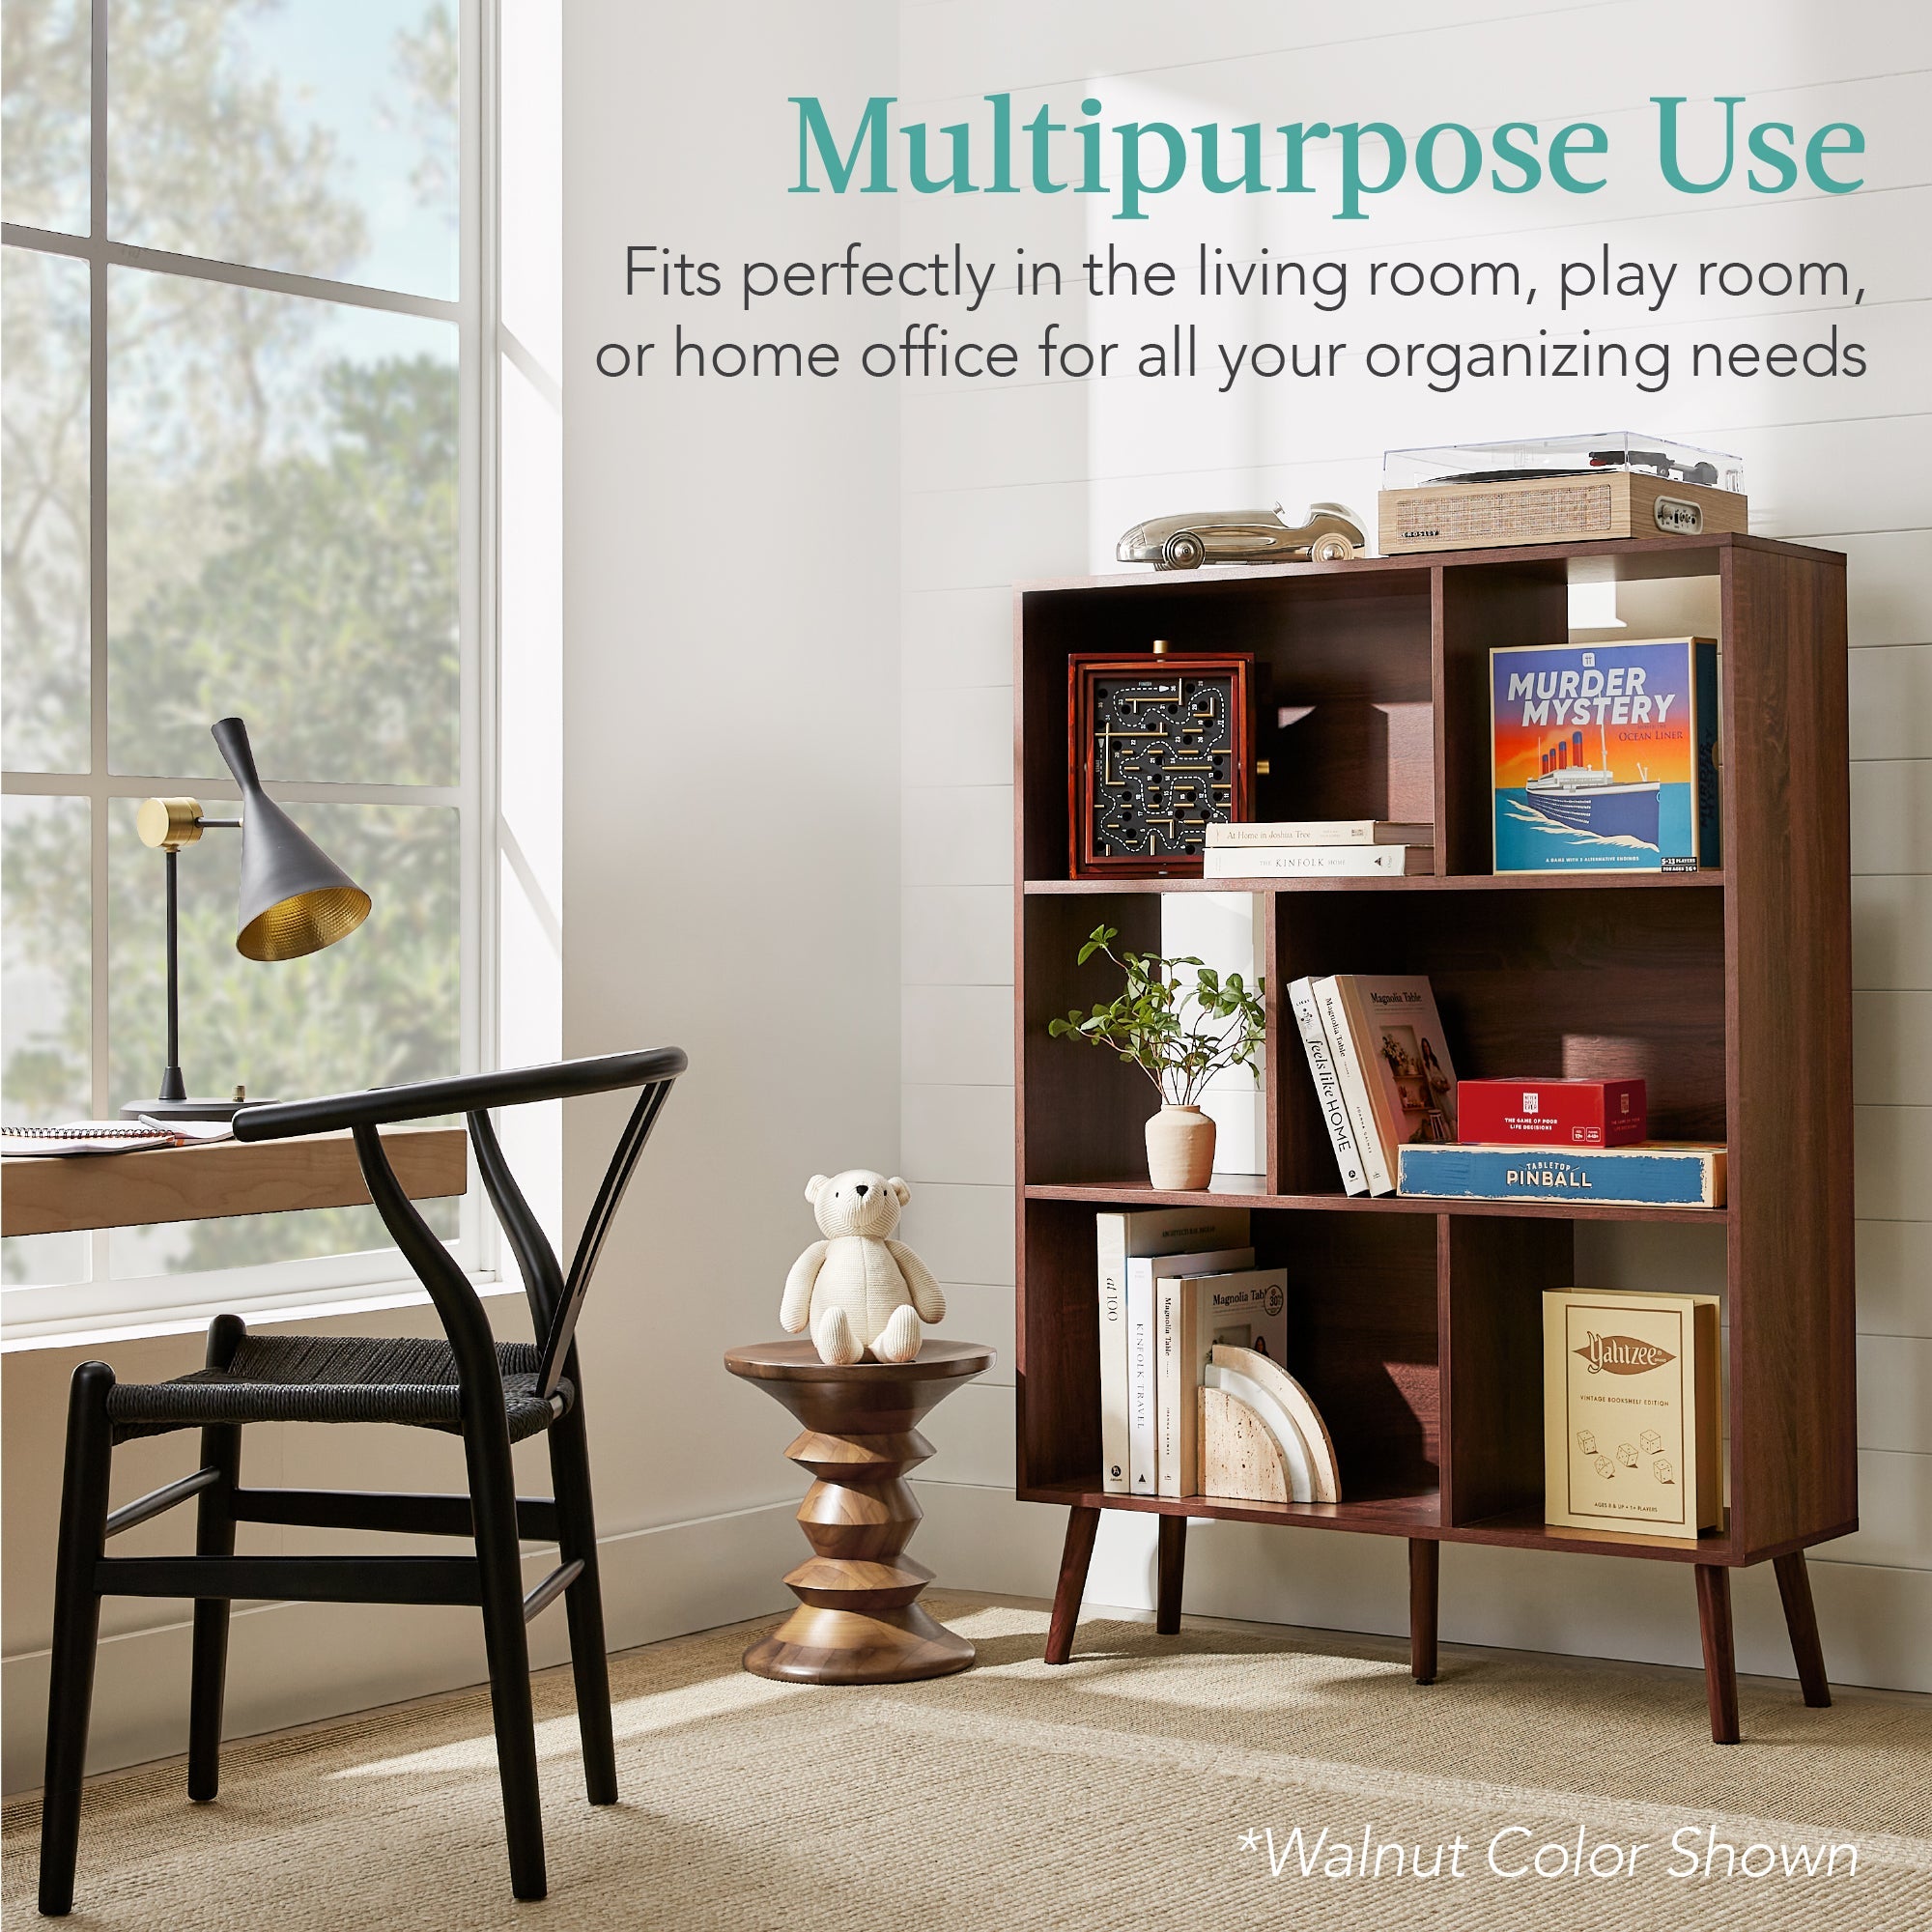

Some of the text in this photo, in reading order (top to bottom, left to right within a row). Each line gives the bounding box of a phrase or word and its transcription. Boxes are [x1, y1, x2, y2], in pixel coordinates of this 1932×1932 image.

[1508, 667, 1646, 701] MURDER
[1522, 695, 1676, 726] MYSTERY
[1619, 730, 1683, 742] OCEAN LINER
[1237, 831, 1259, 839] Home
[1268, 830, 1293, 839] Joshua
[1275, 858, 1324, 867] KINFOLK
[1370, 991, 1423, 1005] Magnolia Table
[1325, 998, 1347, 1058] Magnolia Table
[1306, 1038, 1351, 1152] feels like HOME
[1526, 1161, 1571, 1172] TABLETOP
[1506, 1170, 1593, 1188] PINBALL
[1212, 1291, 1249, 1307] Magnolia
[1250, 1288, 1267, 1301] Tabl
[1107, 1296, 1119, 1321] 100
[1587, 1330, 1657, 1375] Yahtzee
[1607, 1397, 1642, 1406] BOOKSHELF
